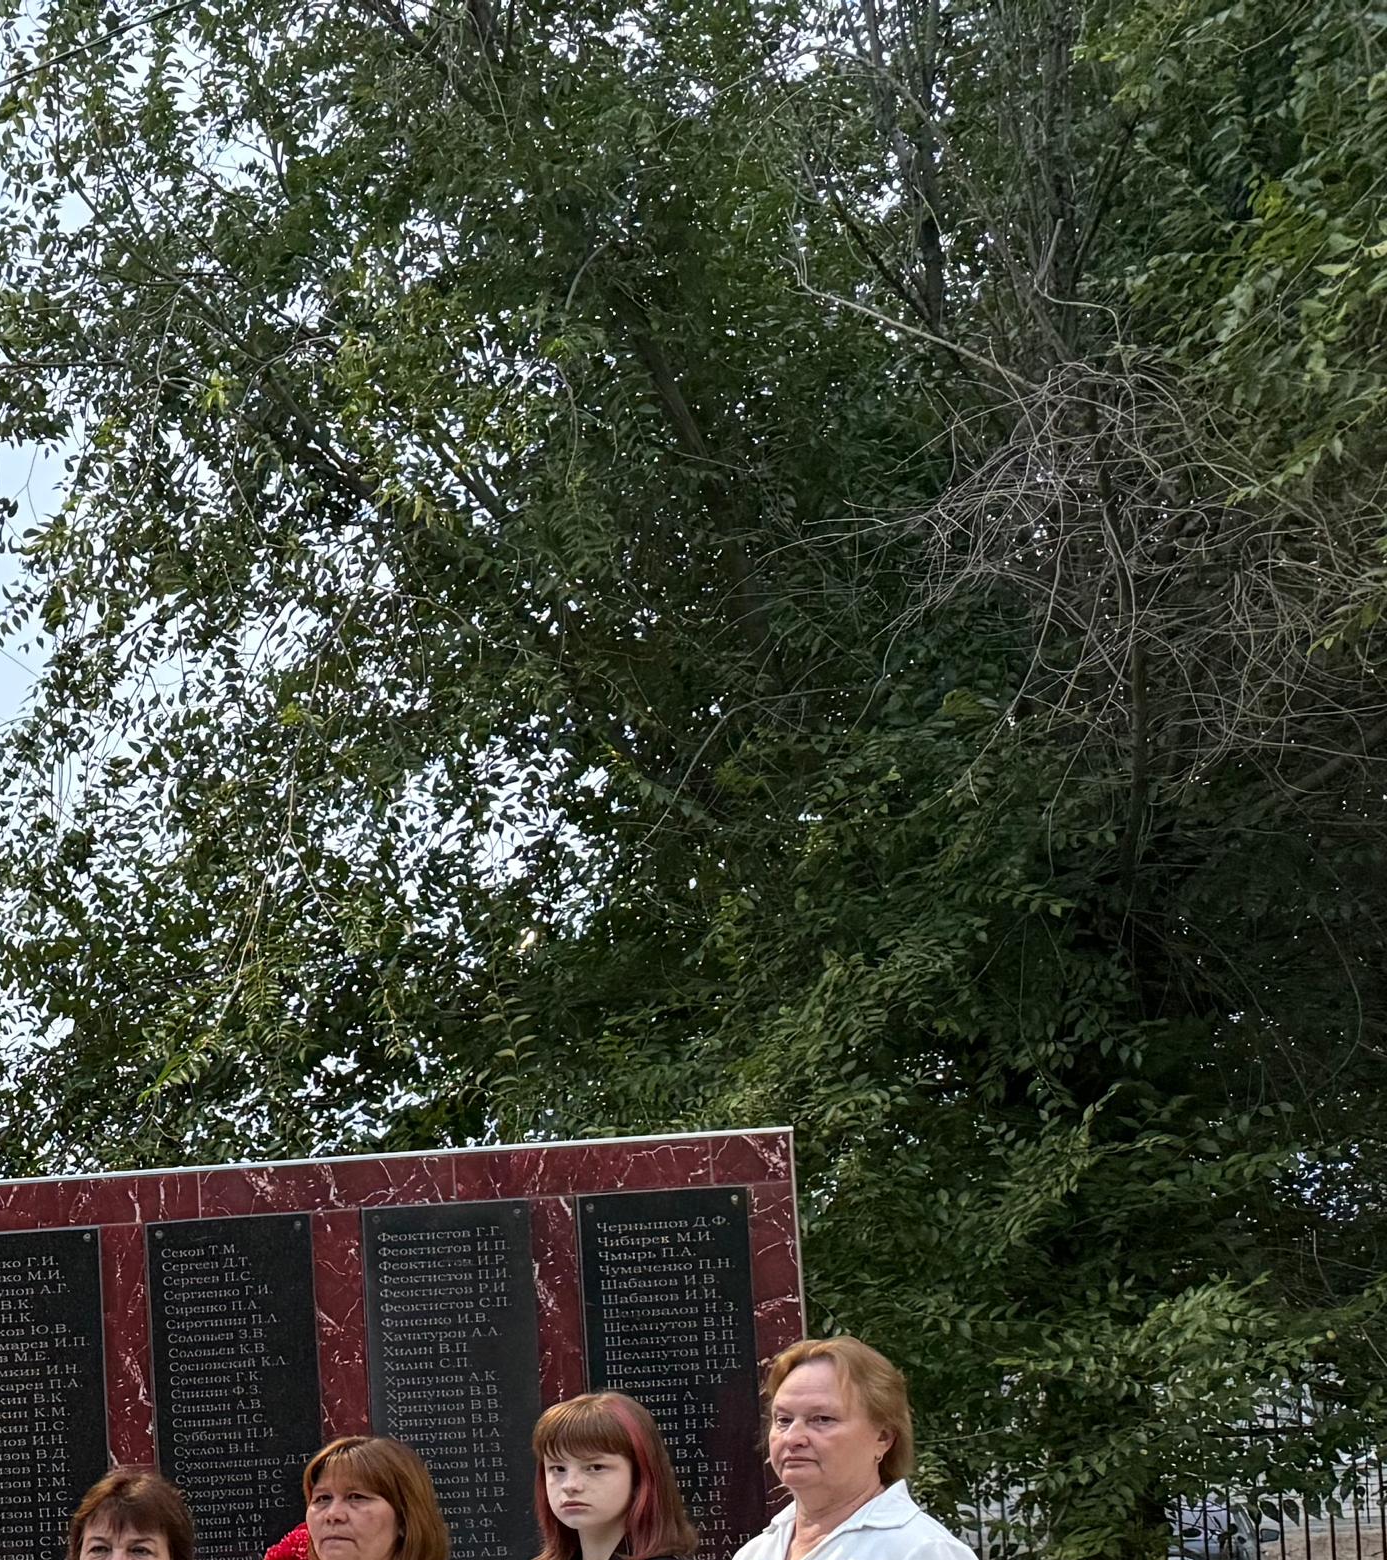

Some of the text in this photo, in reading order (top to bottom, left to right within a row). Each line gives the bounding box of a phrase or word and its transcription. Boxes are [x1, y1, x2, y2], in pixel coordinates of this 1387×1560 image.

[597, 1216, 730, 1234] Чернышов Д.Ф.
[378, 1230, 470, 1243] Феоктистов
[598, 1231, 715, 1247] Чибирек М.И.
[599, 1247, 696, 1262] Чмырь П.А.
[28, 1270, 65, 1280] М.И.
[600, 1262, 693, 1277] Чумаченко
[163, 1276, 219, 1288] Сергеев
[601, 1278, 677, 1290] Шабанов
[41, 1283, 70, 1294] А.Г.
[164, 1285, 273, 1301] Сергиенко Г.И.
[1, 1299, 34, 1309] В.К.
[380, 1302, 473, 1313] Феоктистов
[31, 1324, 71, 1334] Ю.В.
[604, 1316, 738, 1333] Шелапутов В.Н.
[15, 1351, 50, 1362] М.Е.
[46, 1364, 82, 1374] И.Н.
[384, 1361, 433, 1371] Хилин
[385, 1375, 463, 1387] Хрипунов
[174, 1431, 241, 1444] Субботин
